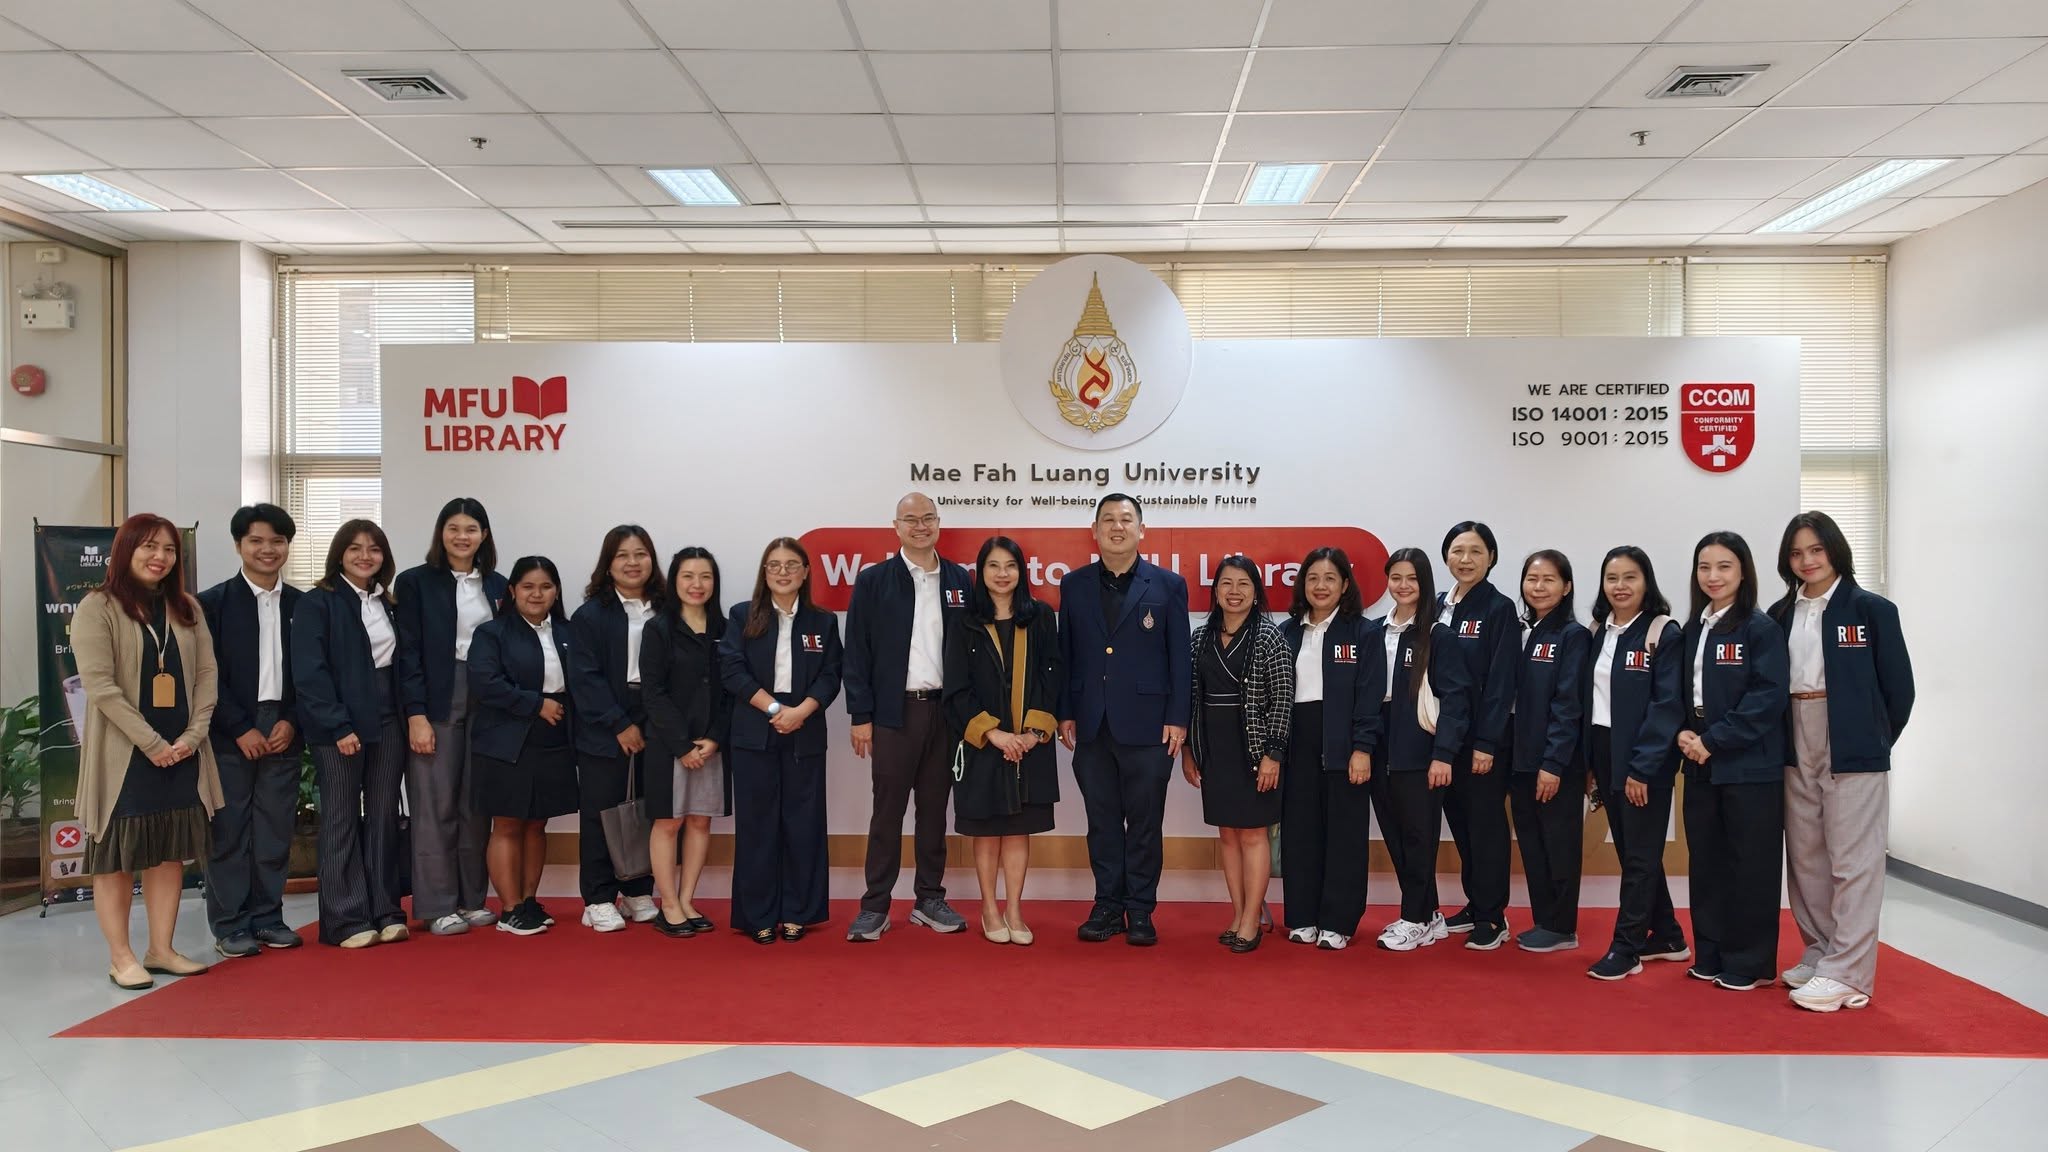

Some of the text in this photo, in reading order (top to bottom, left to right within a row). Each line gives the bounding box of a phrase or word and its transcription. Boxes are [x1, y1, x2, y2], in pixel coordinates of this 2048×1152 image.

[1528, 383, 1670, 396] WE ARE CERTIFIED
[424, 388, 507, 419] MFU
[1688, 389, 1750, 407] CCQM
[1512, 406, 1544, 421] ISO
[1551, 406, 1607, 421] 14001
[1624, 406, 1669, 421] 2015
[1693, 416, 1743, 424] CONFORMITY
[424, 424, 567, 451] LIBRARY
[1512, 431, 1544, 446] ISO
[1561, 431, 1608, 446] 9001
[1624, 431, 1669, 445] 2015
[910, 462, 1260, 486] Mae Fah Luang University
[937, 494, 1257, 508] University for Well-being Sustainable Future
[80, 555, 103, 563] MFU
[1027, 556, 1071, 587] to
